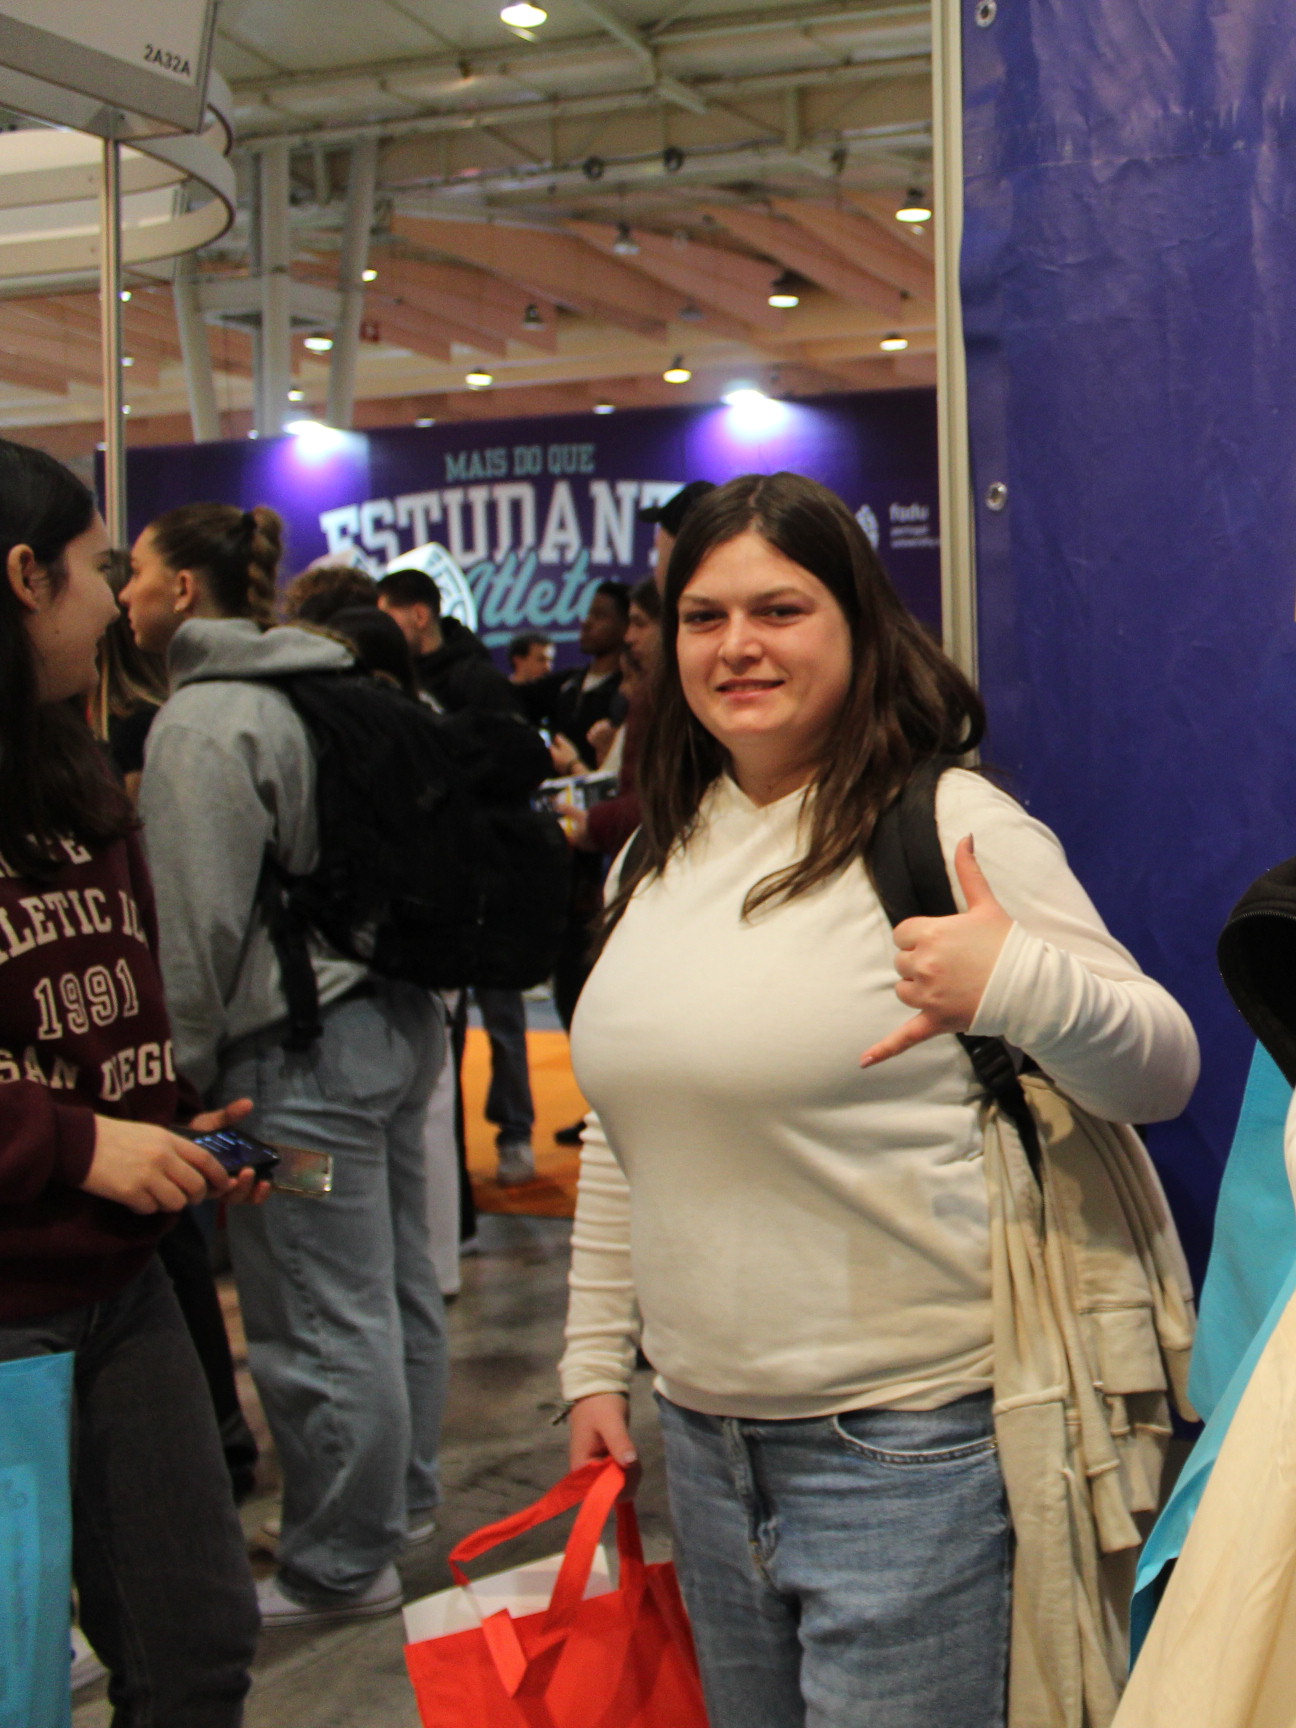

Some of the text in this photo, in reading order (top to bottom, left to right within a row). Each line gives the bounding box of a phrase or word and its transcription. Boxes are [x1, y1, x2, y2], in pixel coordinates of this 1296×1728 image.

[445, 443, 596, 483] MAIS DO QUE
[34, 957, 139, 1040] 1991
